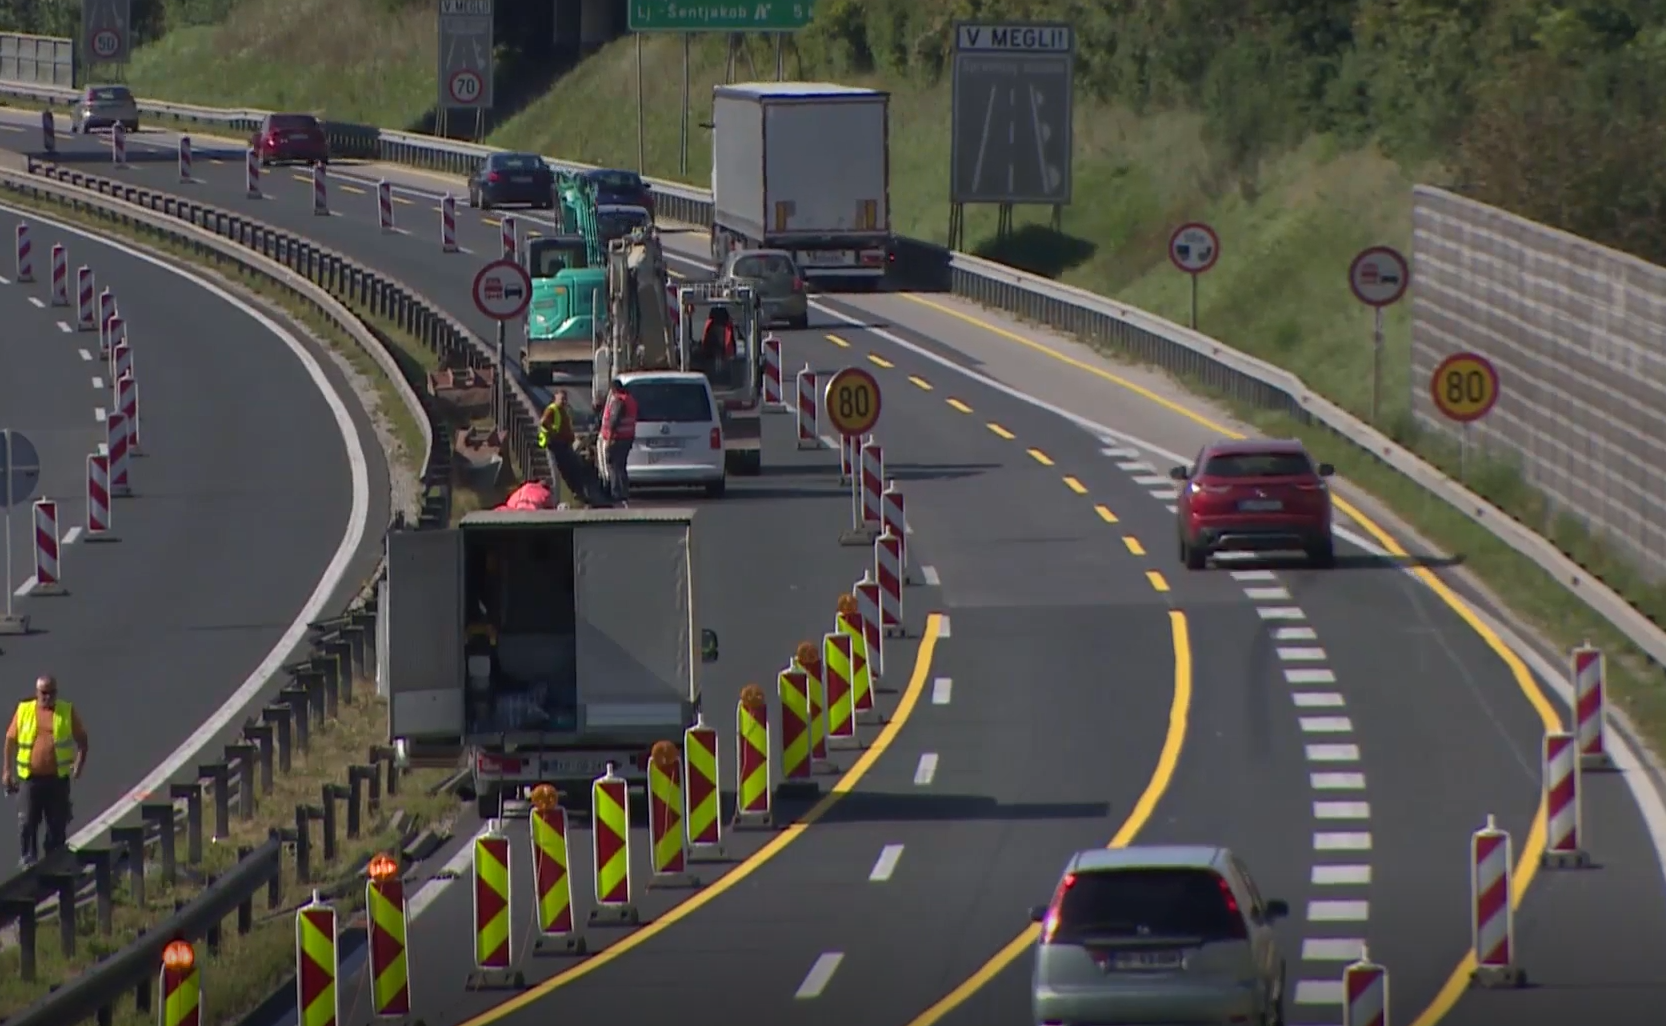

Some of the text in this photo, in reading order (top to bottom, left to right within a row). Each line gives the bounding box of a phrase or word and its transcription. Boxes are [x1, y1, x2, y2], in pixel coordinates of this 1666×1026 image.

[966, 27, 1063, 48] V MEGLI!
[457, 78, 475, 95] 70
[1446, 370, 1484, 404] 80
[840, 385, 869, 418] 80
